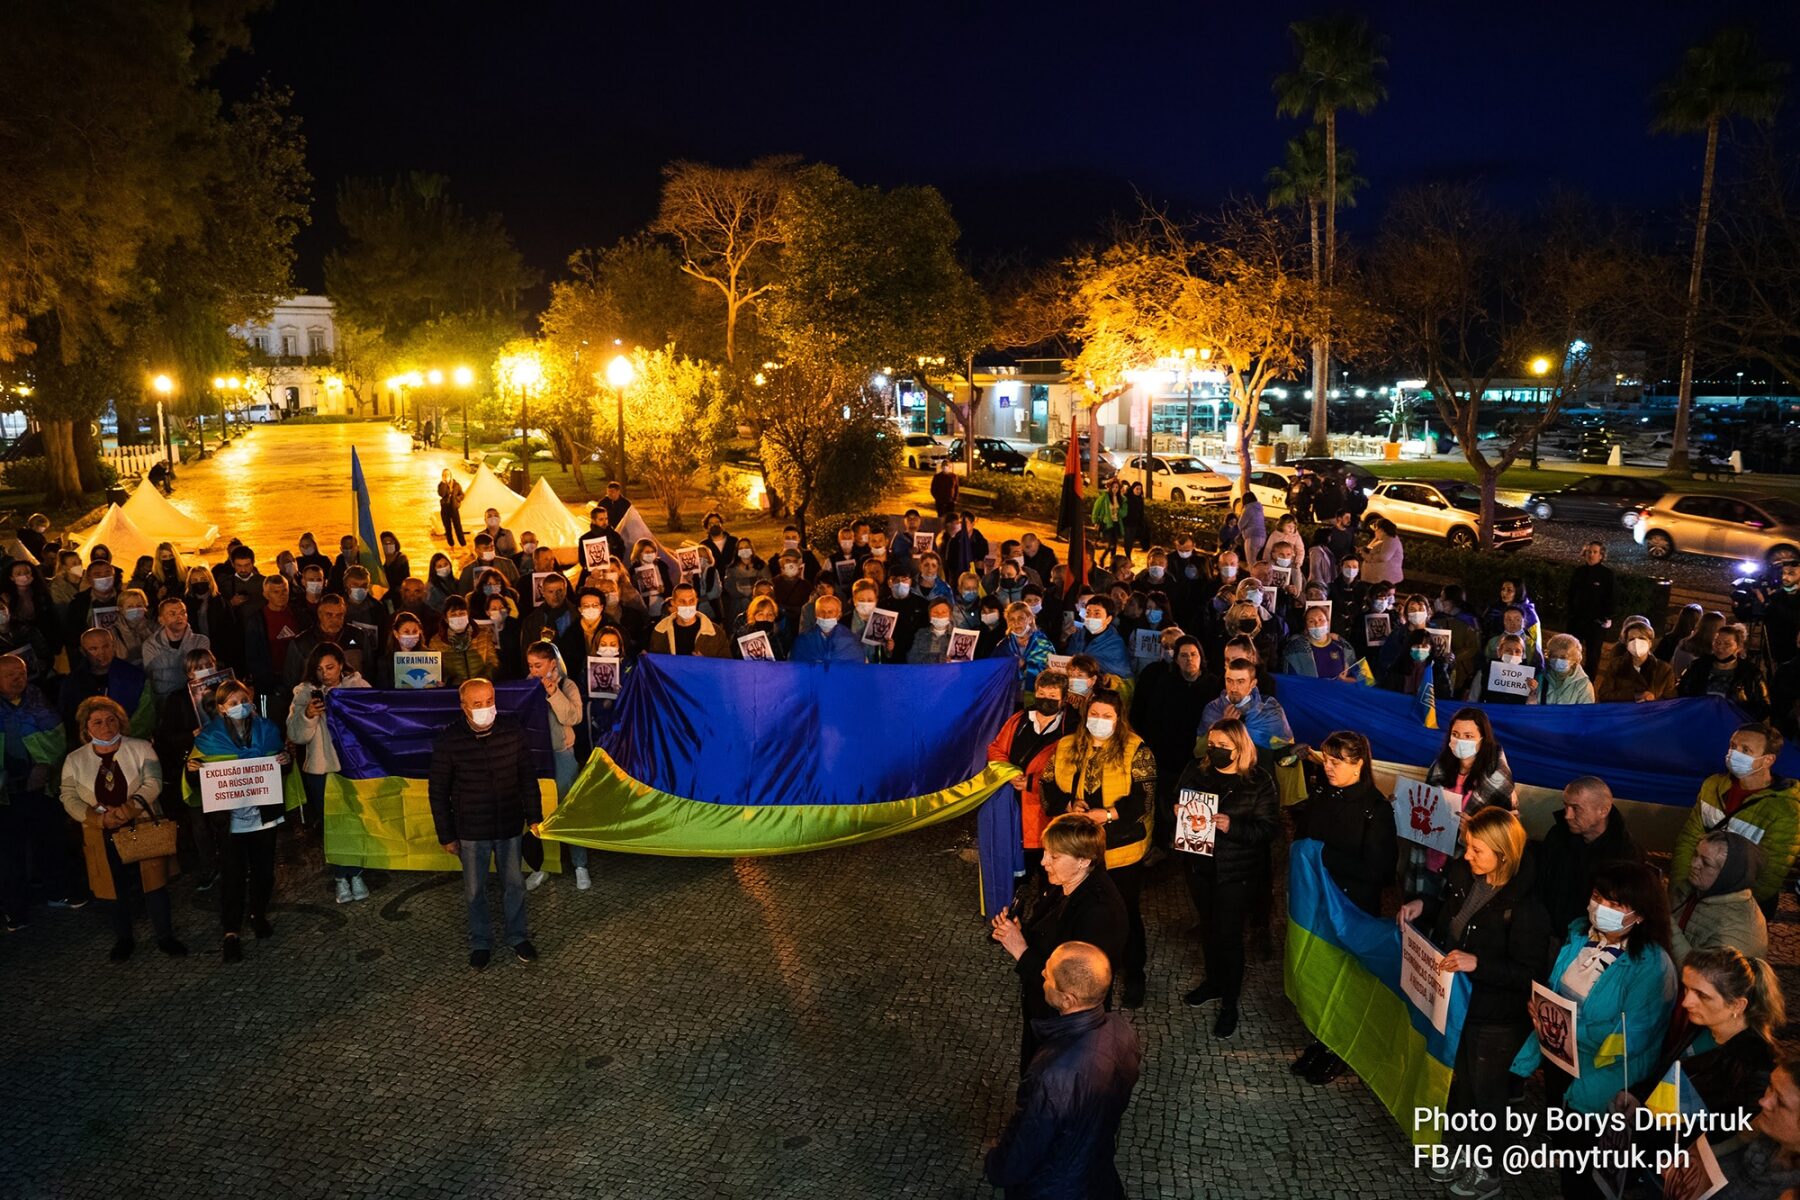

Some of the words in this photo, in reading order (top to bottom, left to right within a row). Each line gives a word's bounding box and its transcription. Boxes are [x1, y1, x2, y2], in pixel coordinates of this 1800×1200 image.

[396, 656, 439, 665] UKRAINIANS
[1502, 670, 1522, 678] STOP
[1494, 679, 1527, 689] GUERRA
[206, 766, 241, 779] EXCLUSÃO
[242, 763, 274, 775] IMEDIATA
[218, 780, 228, 789] DA
[229, 777, 253, 788] RÚSSIA
[255, 776, 264, 784] DO
[215, 790, 245, 800] SISTEMA
[246, 787, 269, 797] SWIFT!
